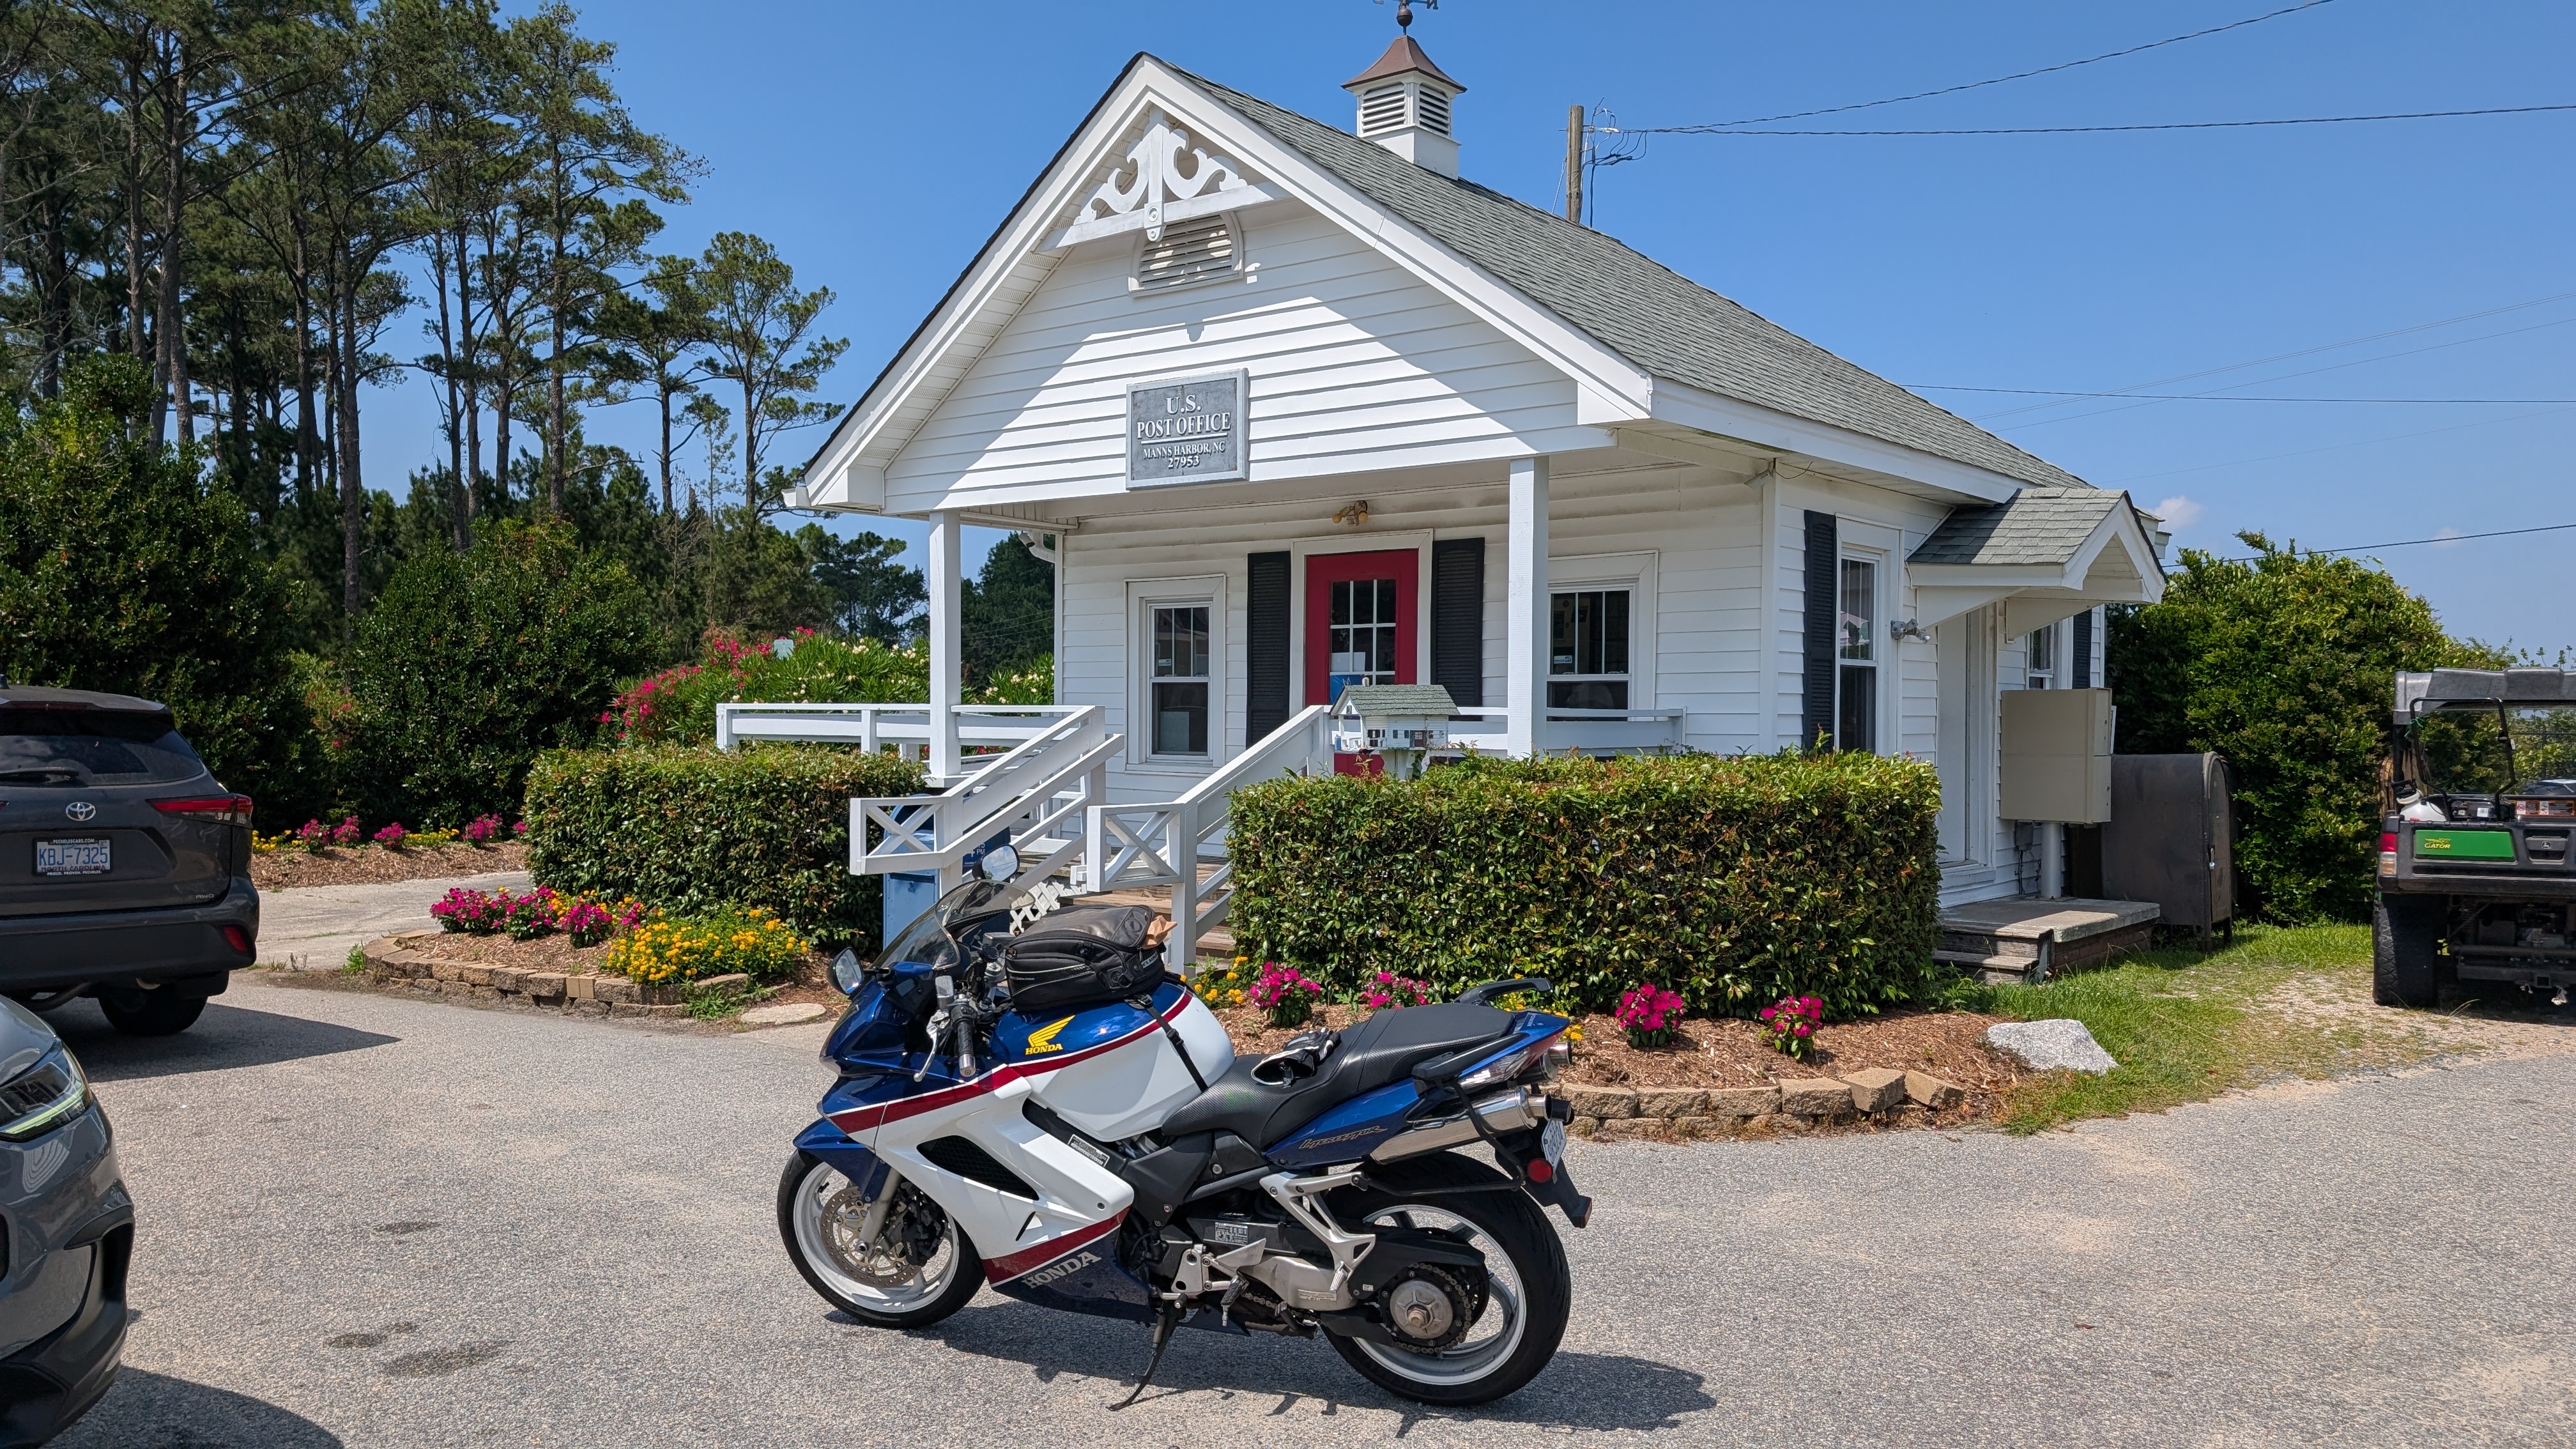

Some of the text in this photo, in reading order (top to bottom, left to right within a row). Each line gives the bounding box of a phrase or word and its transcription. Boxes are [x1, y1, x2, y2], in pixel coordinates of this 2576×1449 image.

[1165, 394, 1202, 415] U.S.
[1137, 411, 1232, 440] POST OFFICE
[1143, 441, 1227, 459] MANNS HARBOR, NC
[1167, 456, 1200, 470] 27953
[39, 847, 108, 866] KBJ-7325
[1025, 1043, 1063, 1055] HONDA
[1020, 1251, 1102, 1289] HONDA
